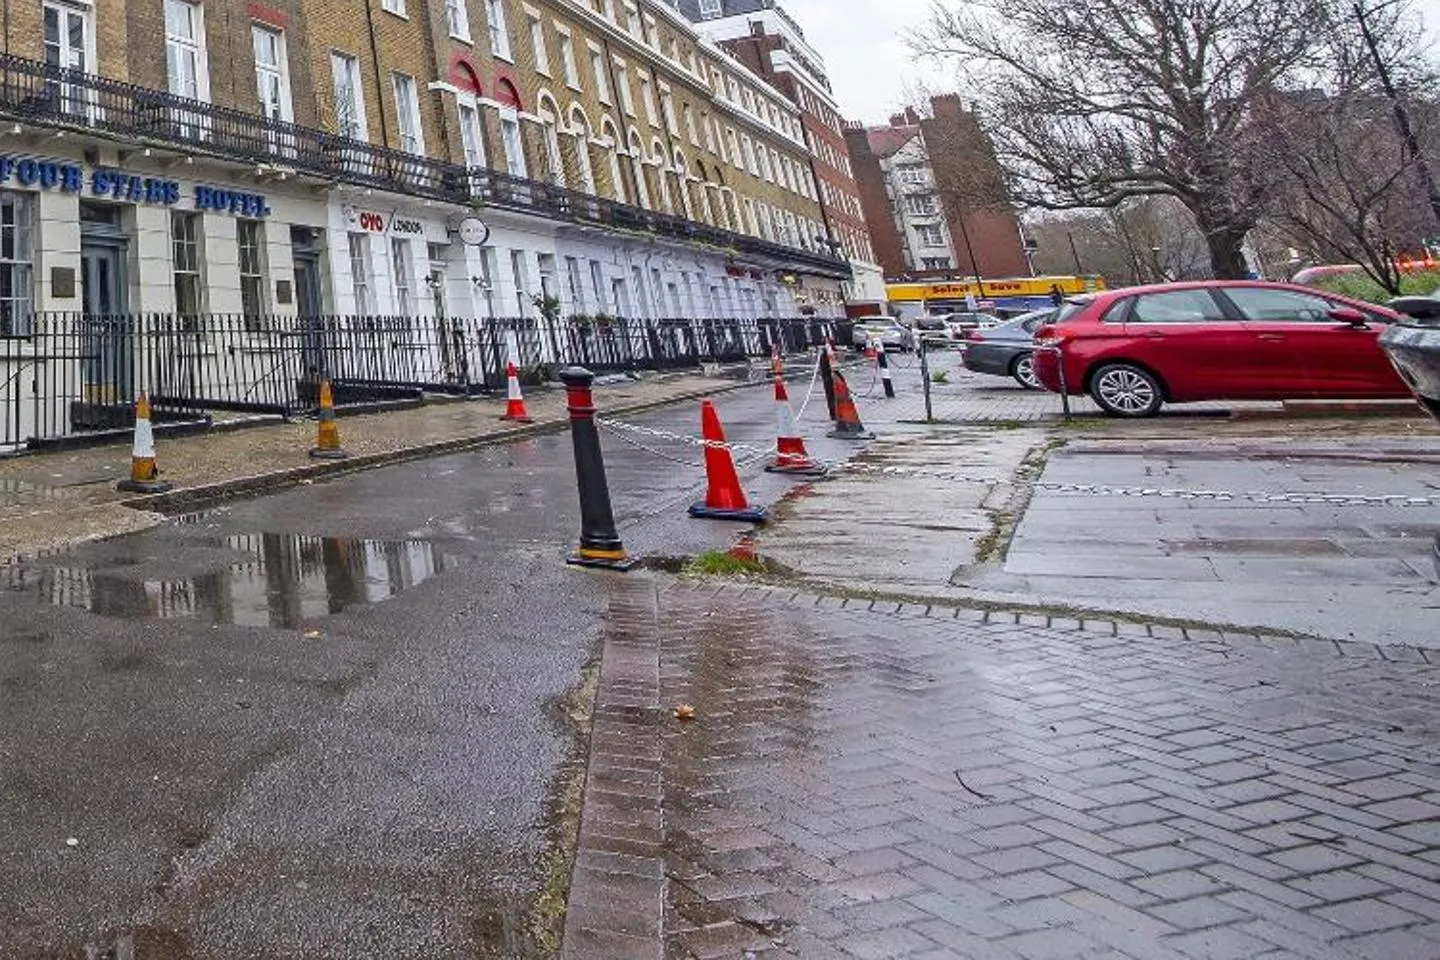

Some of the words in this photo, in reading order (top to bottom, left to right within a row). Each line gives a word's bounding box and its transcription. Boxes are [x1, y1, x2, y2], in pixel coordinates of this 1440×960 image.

[91, 169, 180, 205] STARS
[194, 185, 272, 218] HOTEL
[360, 212, 384, 232] OYO
